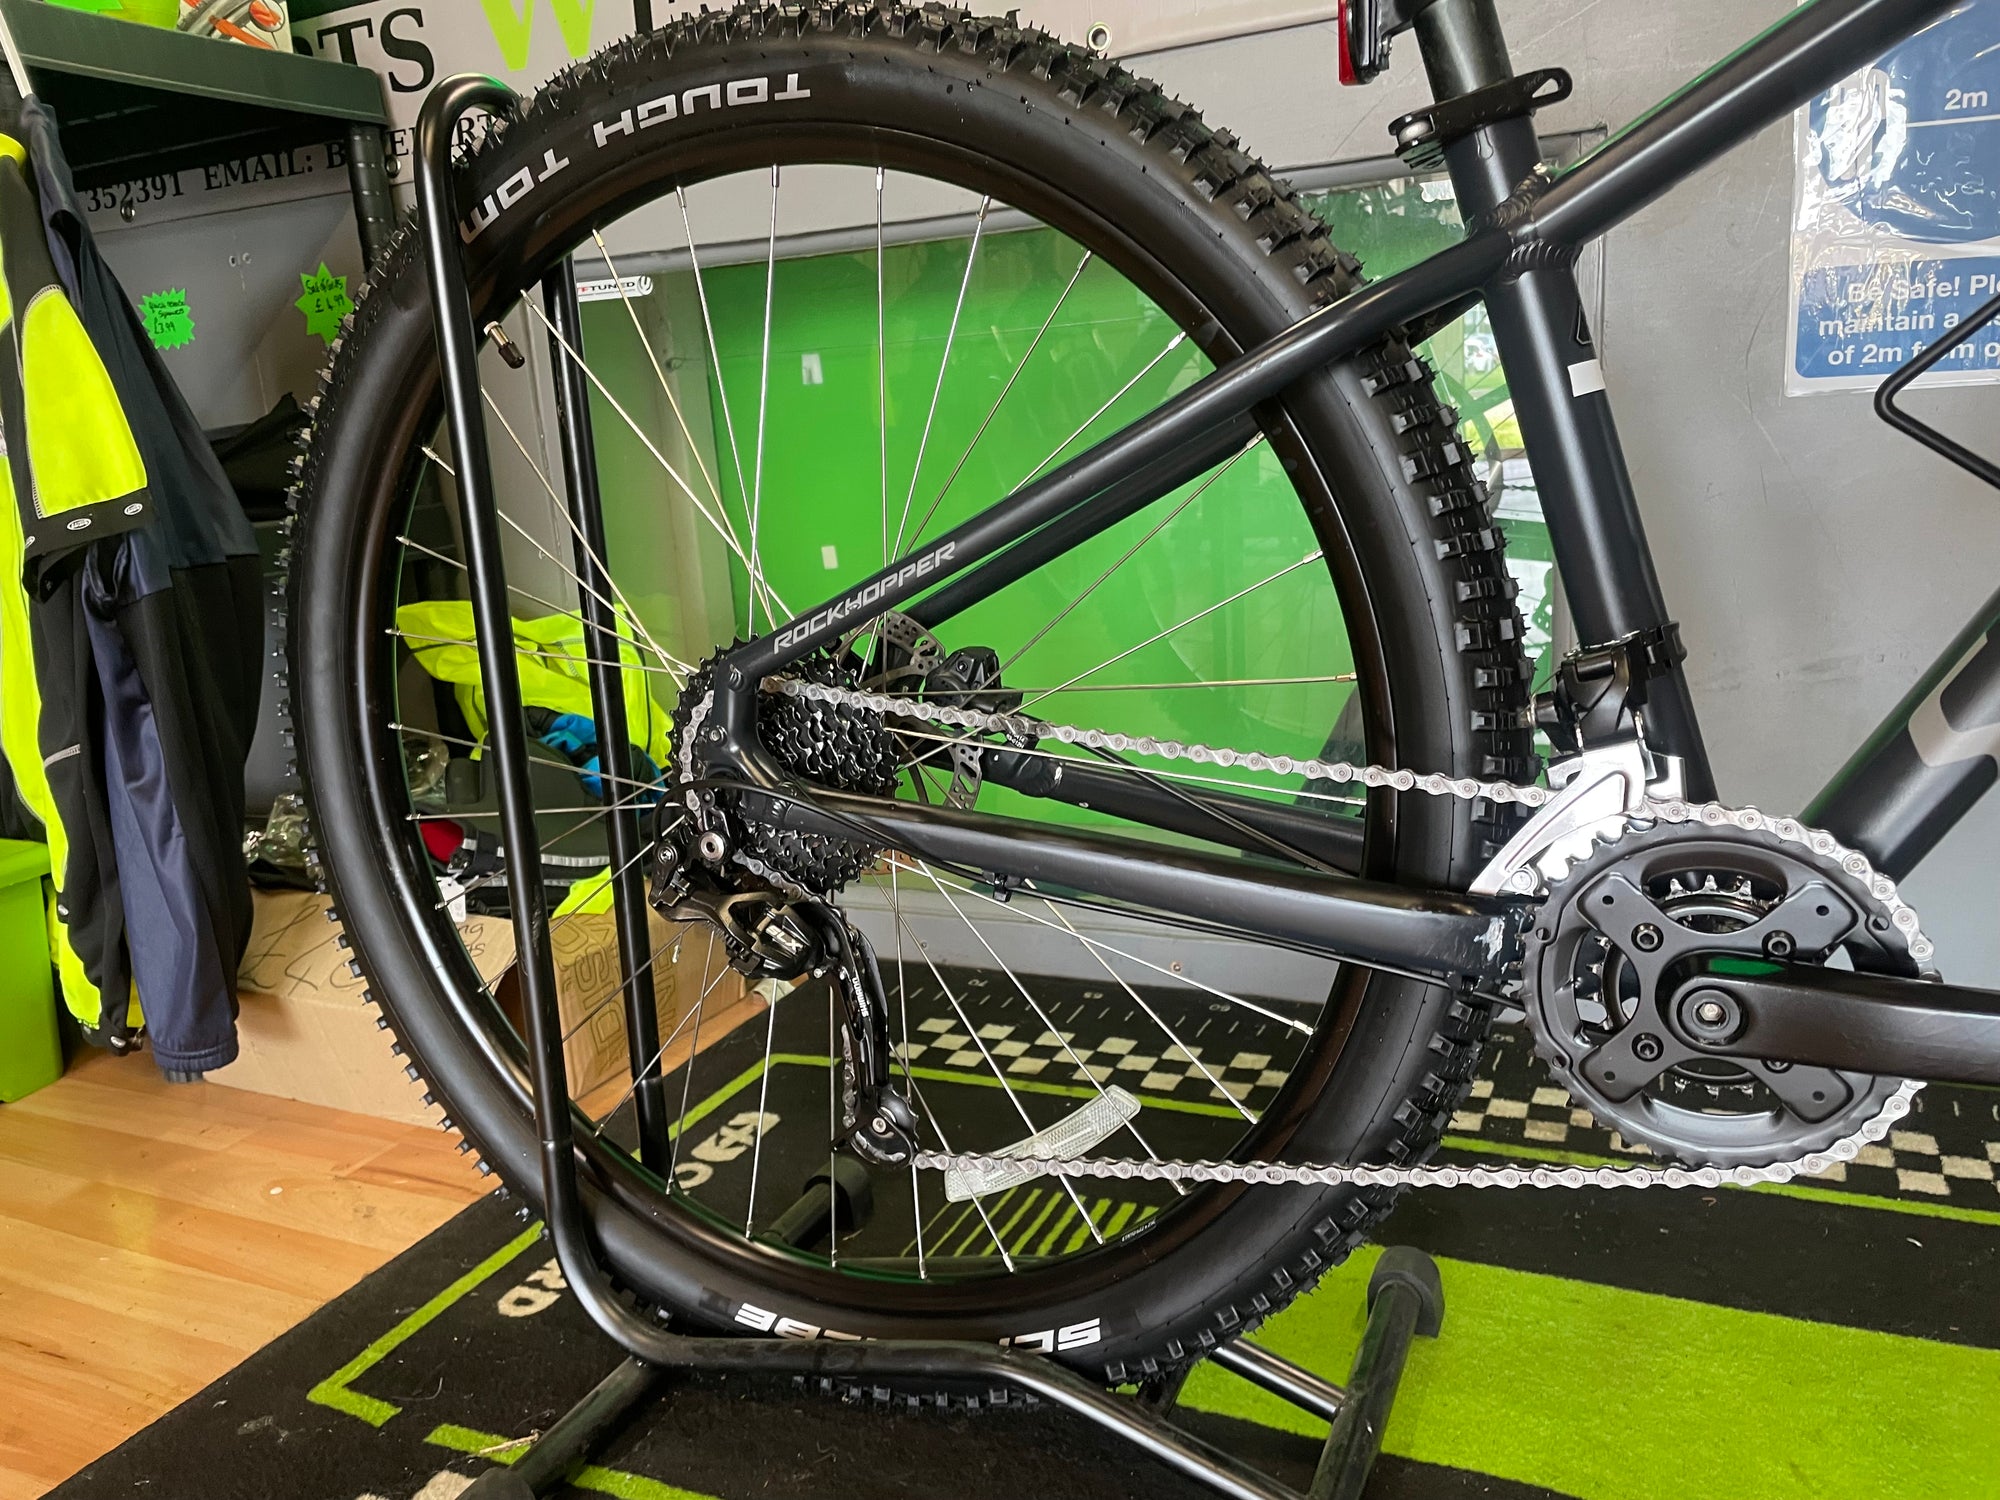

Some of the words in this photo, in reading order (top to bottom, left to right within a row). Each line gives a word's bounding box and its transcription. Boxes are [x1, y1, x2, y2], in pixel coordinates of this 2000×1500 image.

[292, 8, 435, 93] TS
[593, 72, 812, 148] TOUGH
[1944, 88, 1988, 111] 2m
[203, 152, 313, 192] EMAIL:
[459, 149, 570, 244] TOM
[1848, 282, 1883, 303] Be
[1891, 276, 1961, 300] Safe!
[1818, 310, 1935, 337] maintain
[1943, 312, 1959, 328] a
[1828, 344, 1855, 366] of
[1862, 343, 1902, 364] 2m
[773, 540, 957, 655] ROCKHOPPER
[765, 925, 804, 953] SLX
